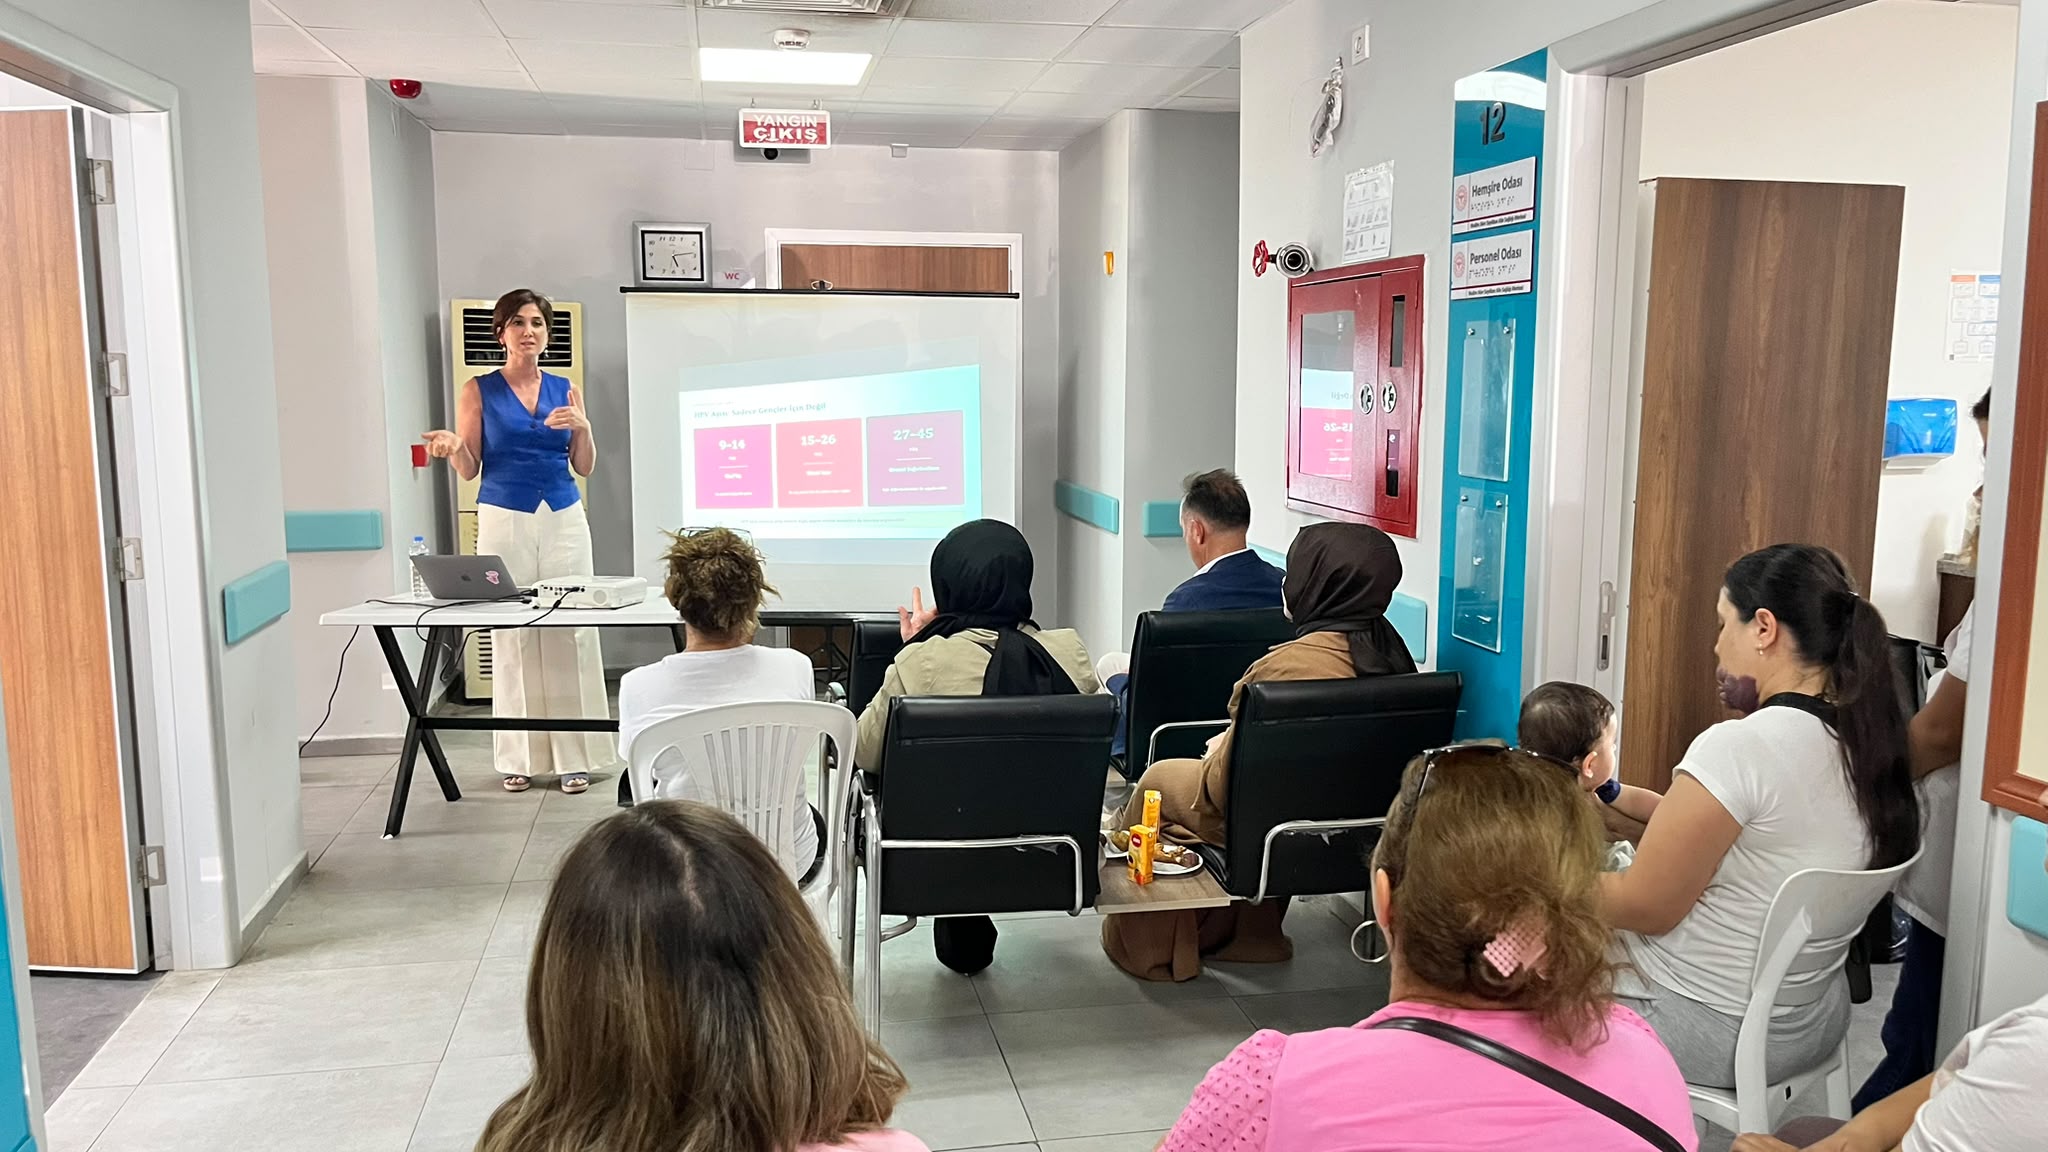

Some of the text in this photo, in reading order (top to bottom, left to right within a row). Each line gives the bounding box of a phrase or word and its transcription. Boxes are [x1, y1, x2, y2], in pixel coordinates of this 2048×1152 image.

[754, 114, 817, 127] YANGIN
[1480, 101, 1505, 145] 12
[1471, 176, 1523, 198] Hemşire Odası
[1469, 246, 1522, 265] Personel Odası
[724, 272, 740, 280] WC
[758, 405, 788, 415] Gençler
[805, 402, 826, 412] Değil
